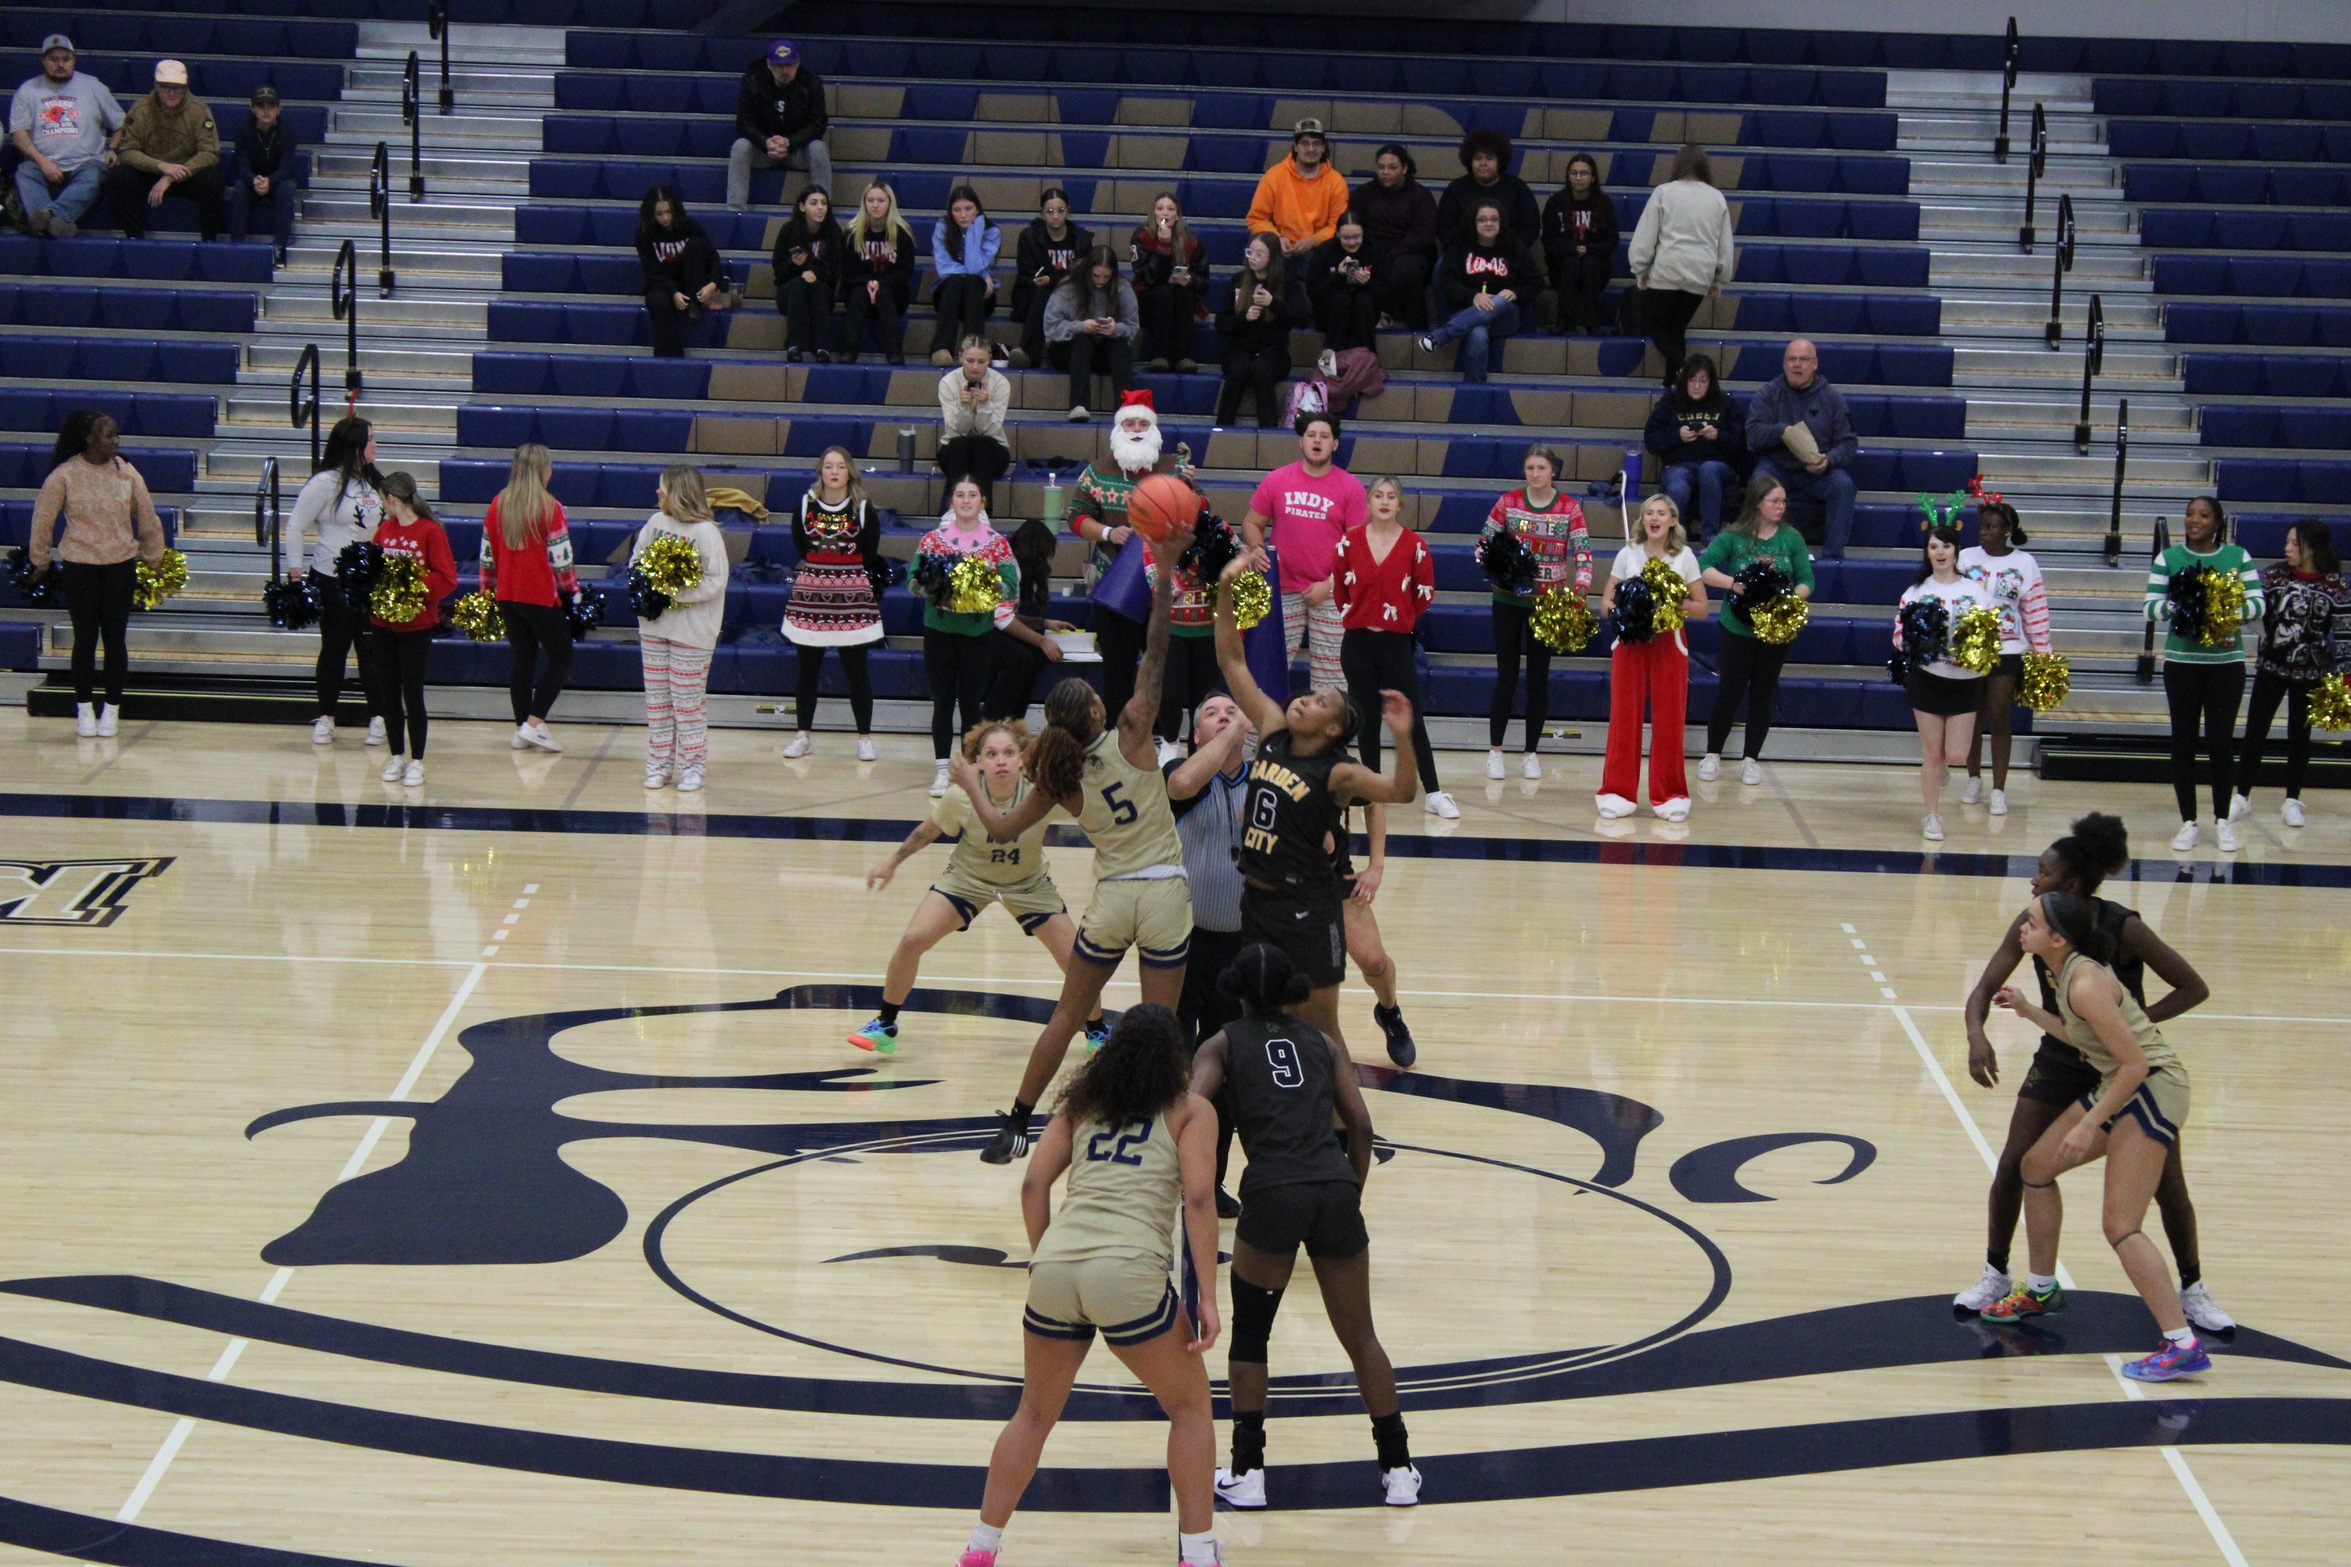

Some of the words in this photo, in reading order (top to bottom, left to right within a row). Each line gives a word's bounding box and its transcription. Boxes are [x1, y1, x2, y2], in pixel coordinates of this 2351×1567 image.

[42, 128, 79, 136] CHAMPIONS
[1284, 491, 1335, 513] INDY
[1285, 506, 1327, 520] PIRATES
[1249, 759, 1311, 803] GARDEN
[1101, 780, 1138, 825] 5
[1253, 787, 1278, 831] 6
[991, 848, 1020, 864] 24
[1244, 826, 1279, 855] CITY
[1265, 1038, 1304, 1088] 9
[1085, 1118, 1154, 1166] 22
